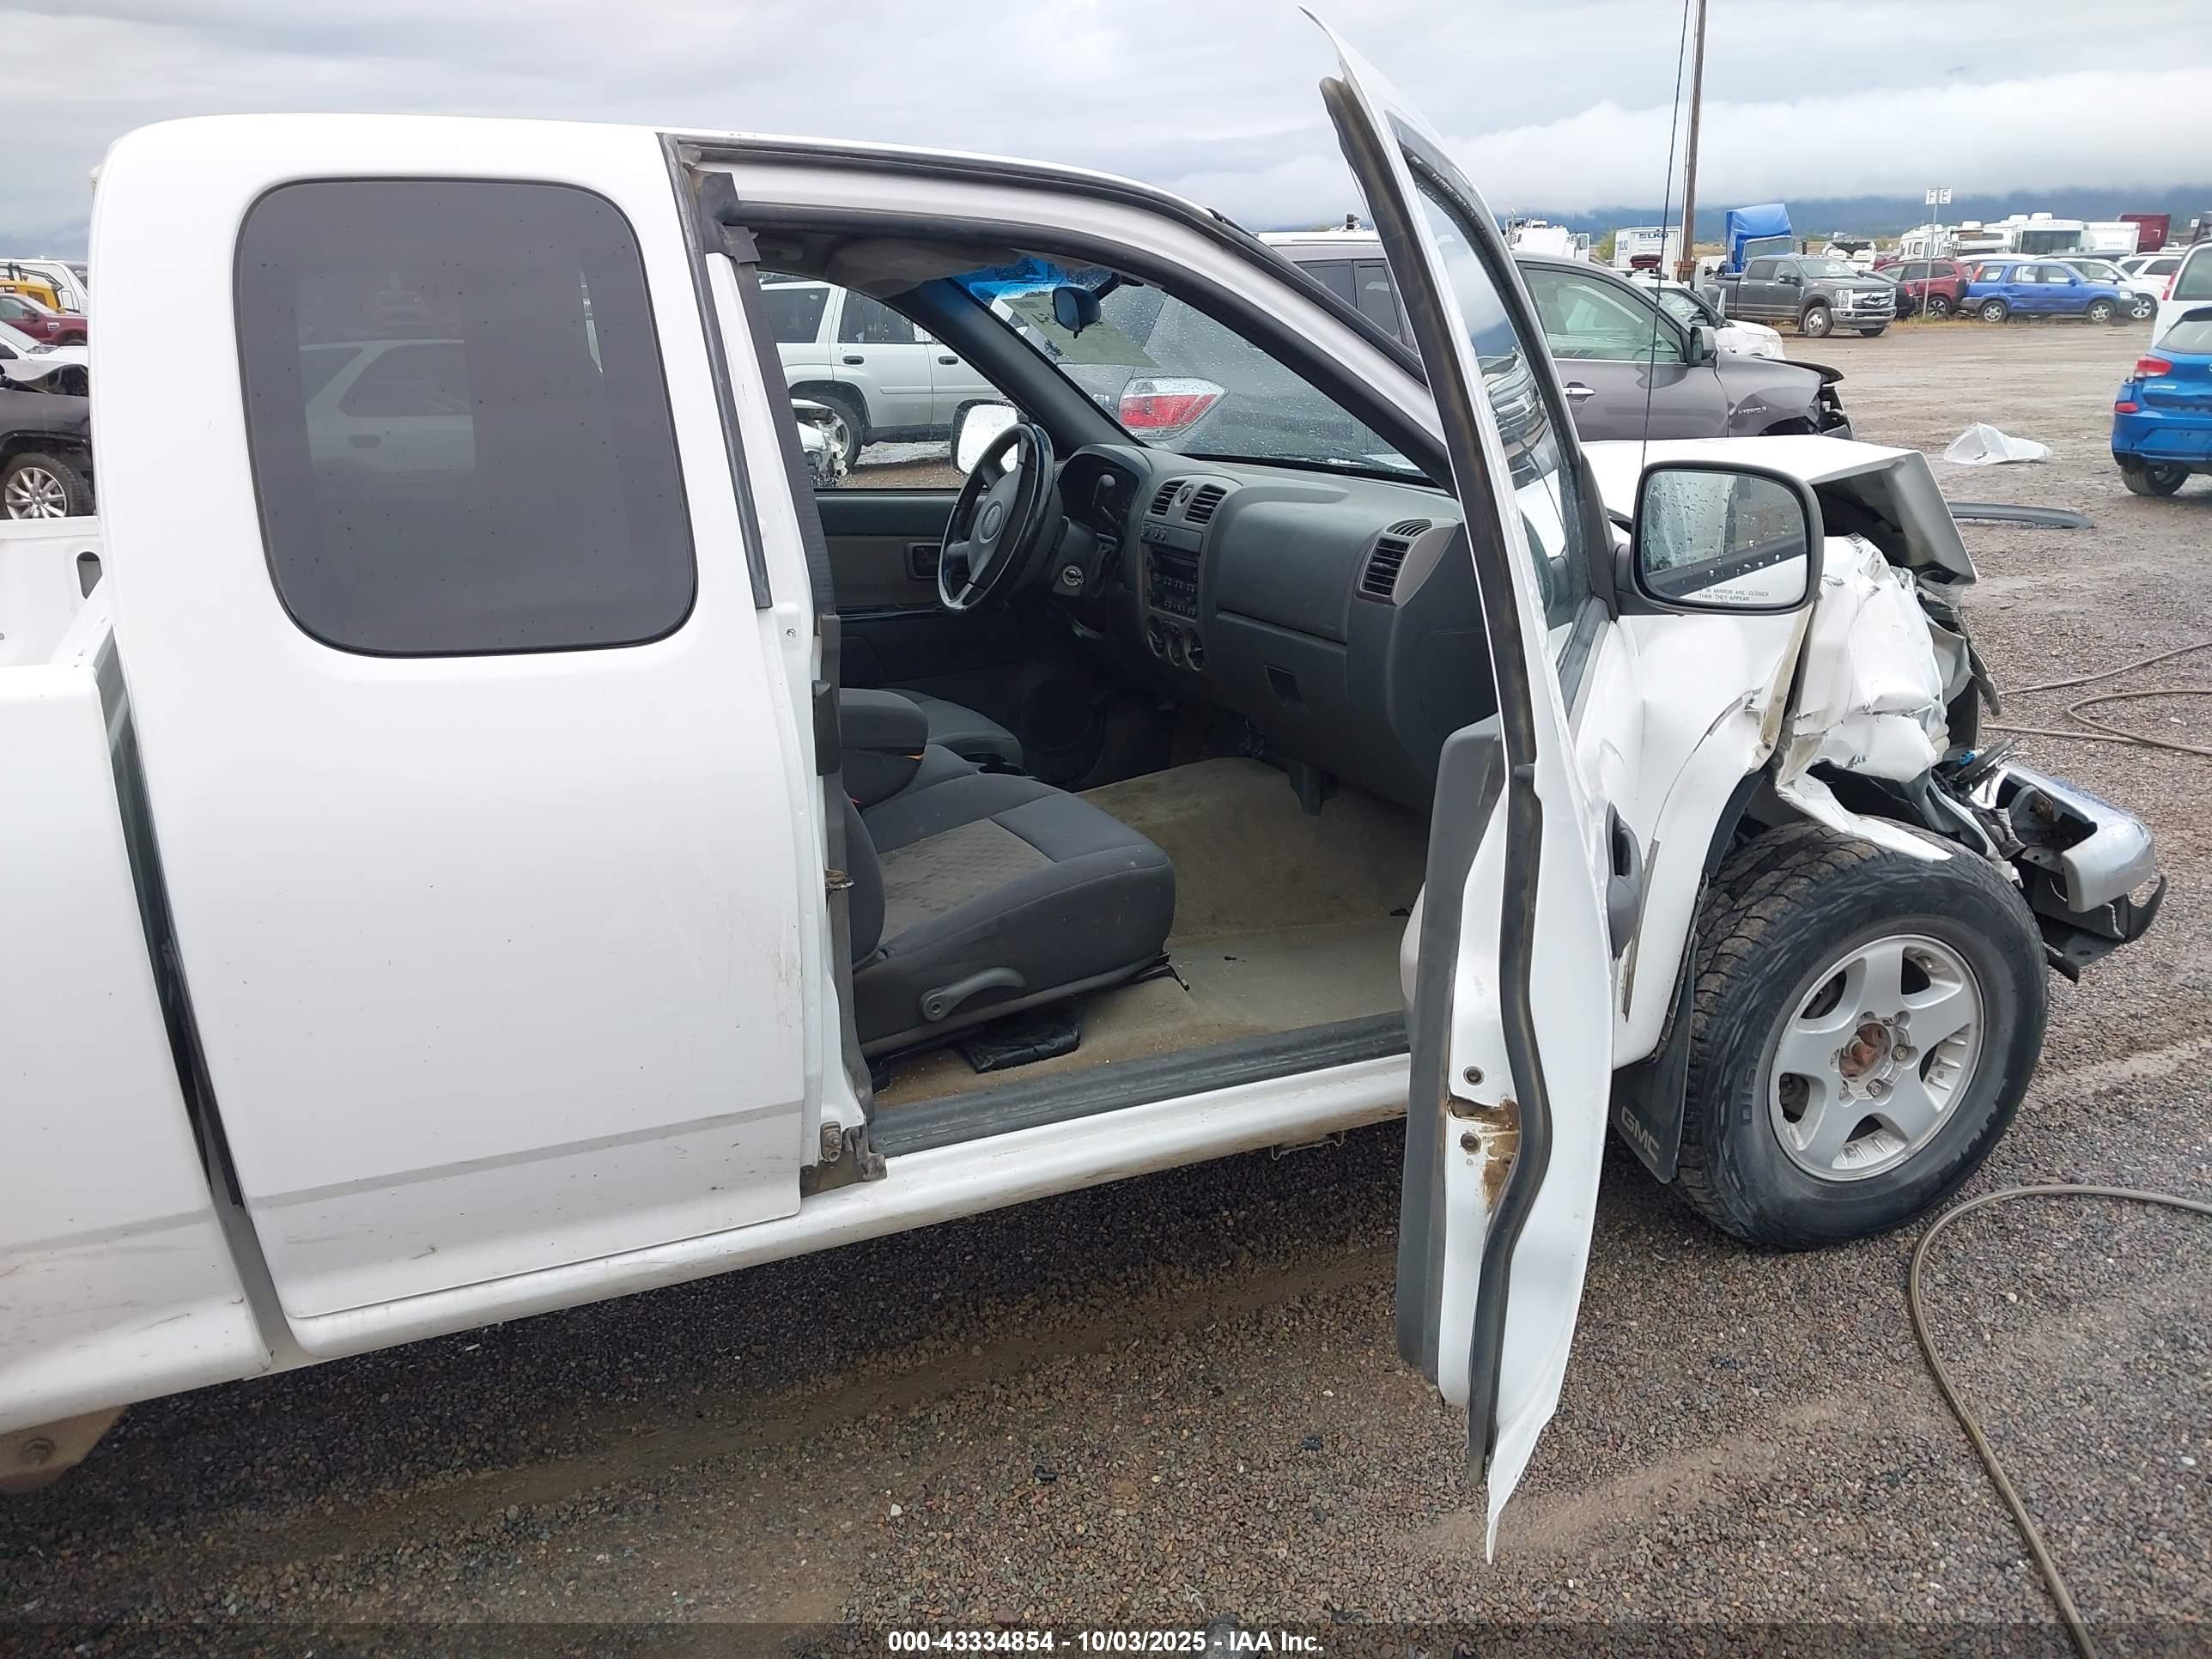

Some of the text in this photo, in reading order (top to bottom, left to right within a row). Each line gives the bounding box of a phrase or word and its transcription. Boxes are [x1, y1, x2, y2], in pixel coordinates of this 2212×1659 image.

[1929, 190, 1948, 203] F E
[1620, 1105, 1660, 1163] GMC
